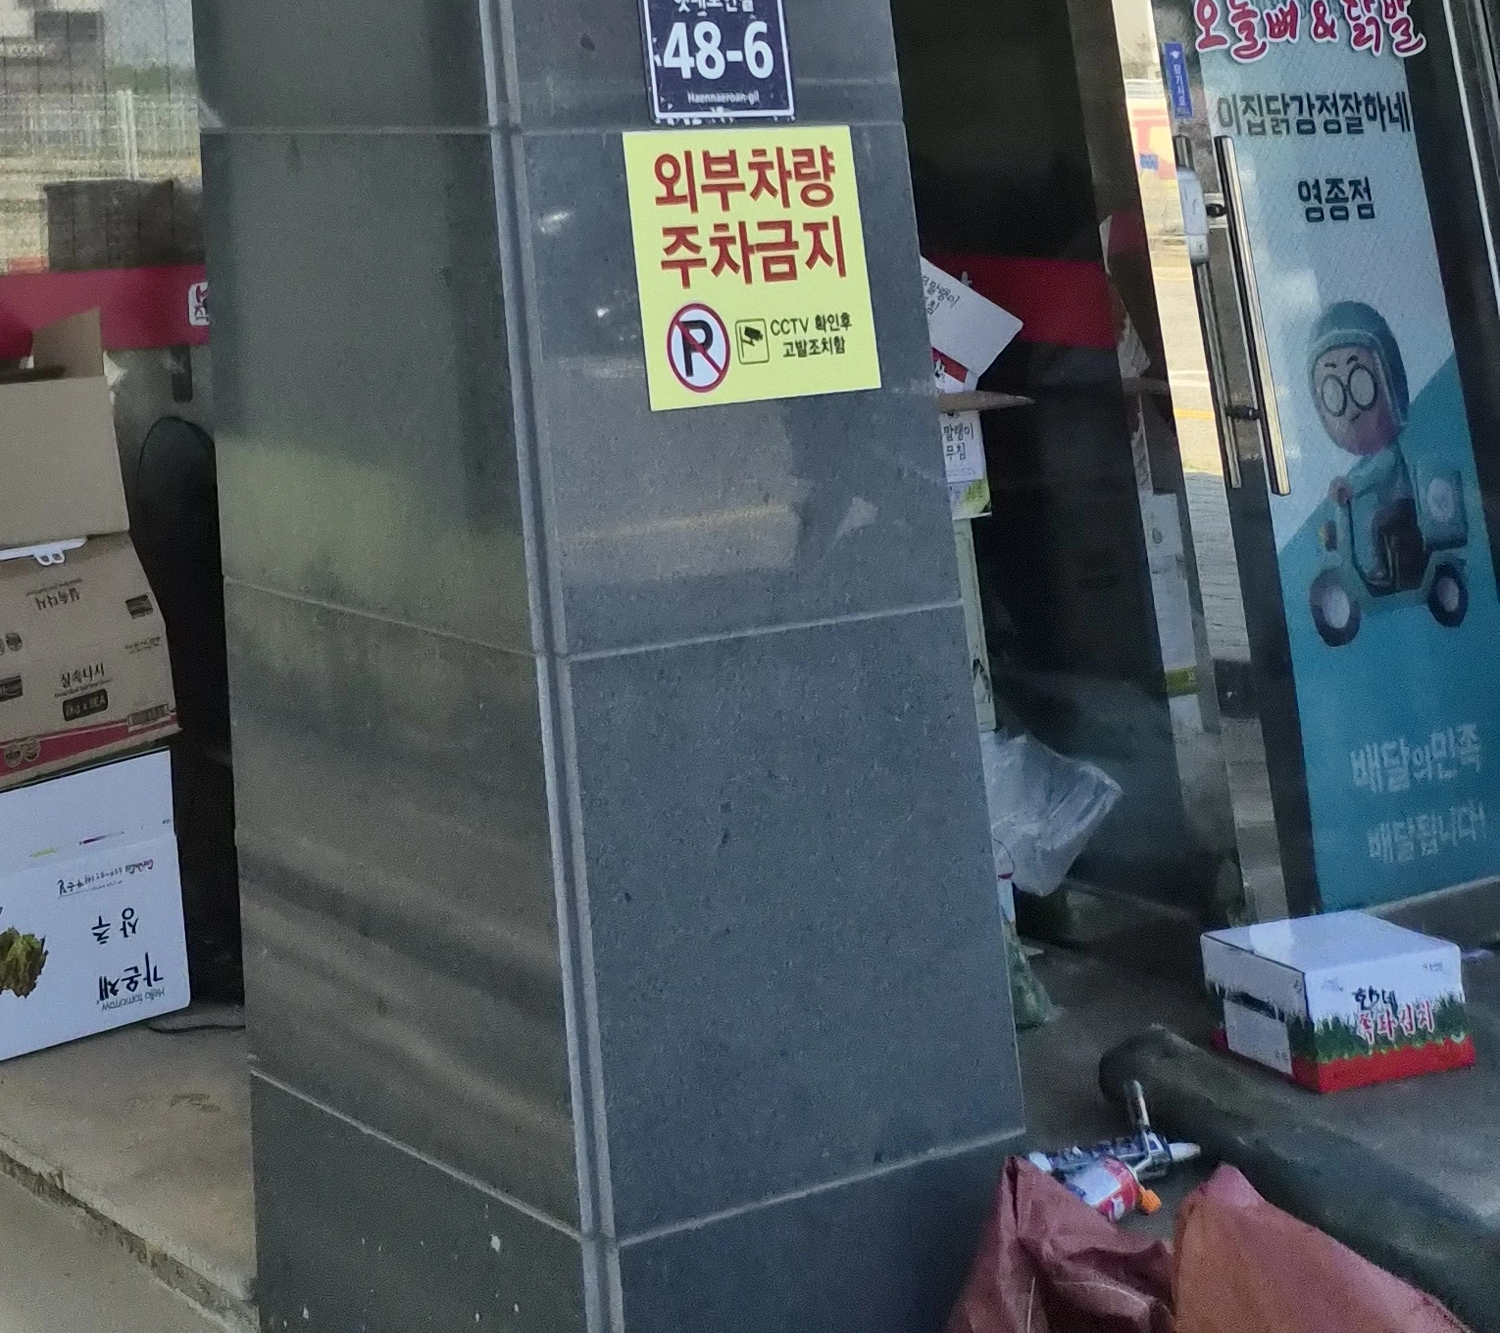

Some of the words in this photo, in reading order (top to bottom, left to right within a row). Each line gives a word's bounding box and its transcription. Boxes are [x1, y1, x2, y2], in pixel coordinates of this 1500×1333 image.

[662, 20, 774, 80] 48-6
[654, 144, 836, 214] 외부차량
[1297, 176, 1376, 222] 영종점
[660, 215, 847, 290] 주차금지
[770, 317, 809, 336] CCTV
[782, 335, 846, 358] 고발조치함
[1350, 723, 1481, 793] 배달의민족
